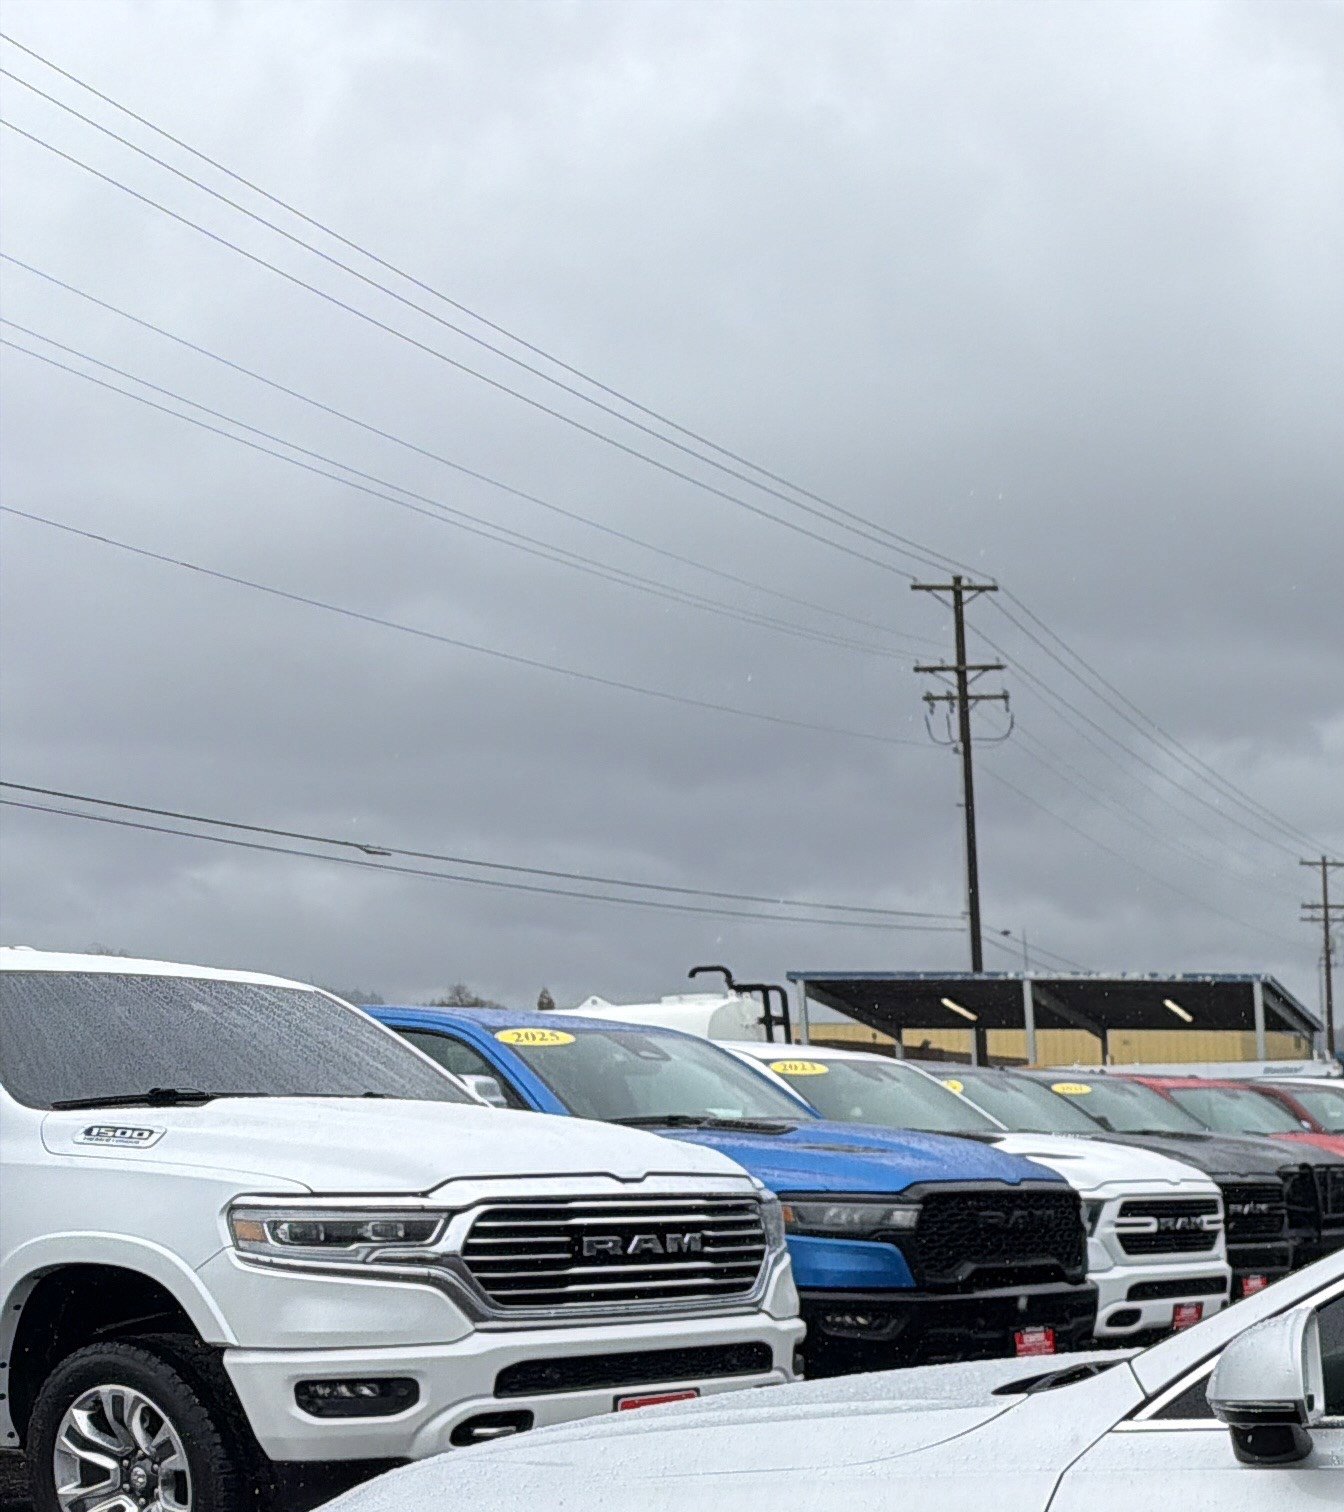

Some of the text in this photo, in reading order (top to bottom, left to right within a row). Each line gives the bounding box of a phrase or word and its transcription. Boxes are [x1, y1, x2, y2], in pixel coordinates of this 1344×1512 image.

[511, 1031, 560, 1043] 2025
[91, 1126, 151, 1140] 1500
[1159, 1216, 1204, 1231] RAM
[582, 1233, 702, 1257] RAM
